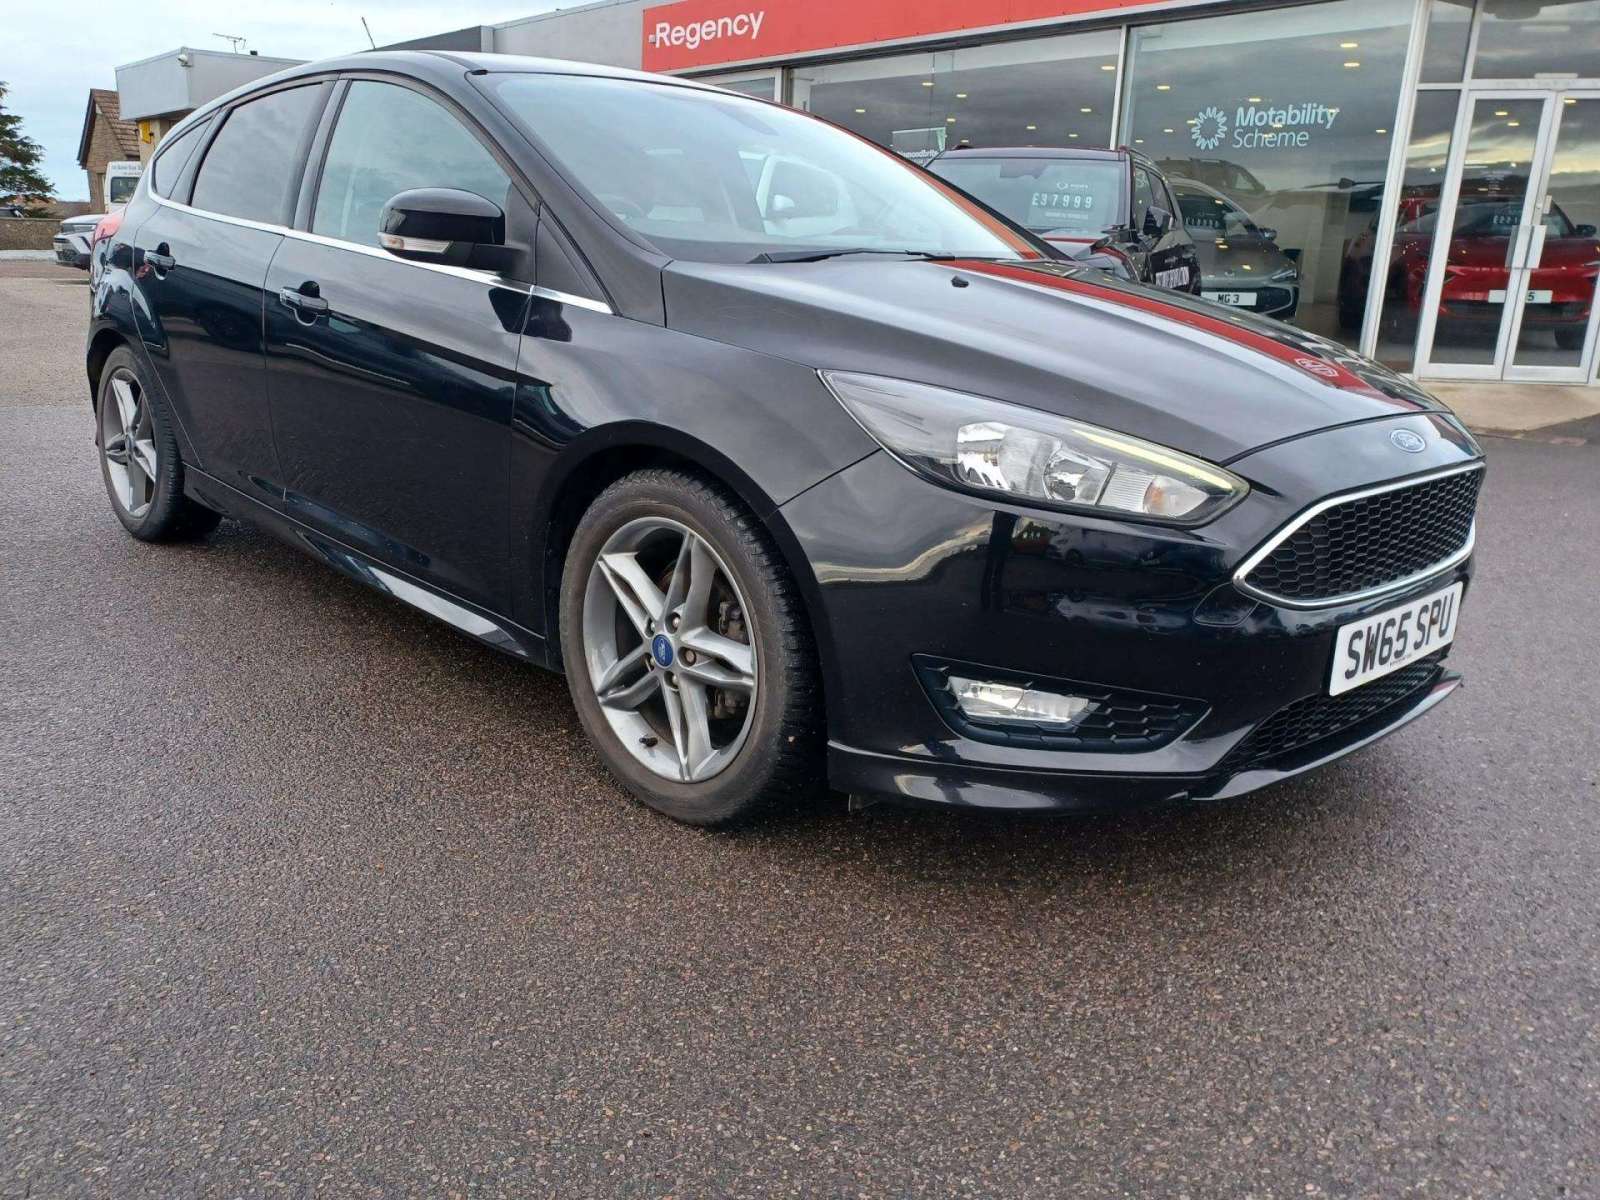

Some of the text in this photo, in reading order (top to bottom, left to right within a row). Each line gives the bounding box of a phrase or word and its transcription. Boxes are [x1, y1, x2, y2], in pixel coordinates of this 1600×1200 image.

[655, 11, 765, 49] Regency
[1235, 103, 1340, 129] Motability
[1232, 128, 1309, 148] Scheme
[1032, 192, 1093, 209] £37999
[1217, 294, 1240, 304] MG 3
[1344, 591, 1454, 680] SW65 SPU
